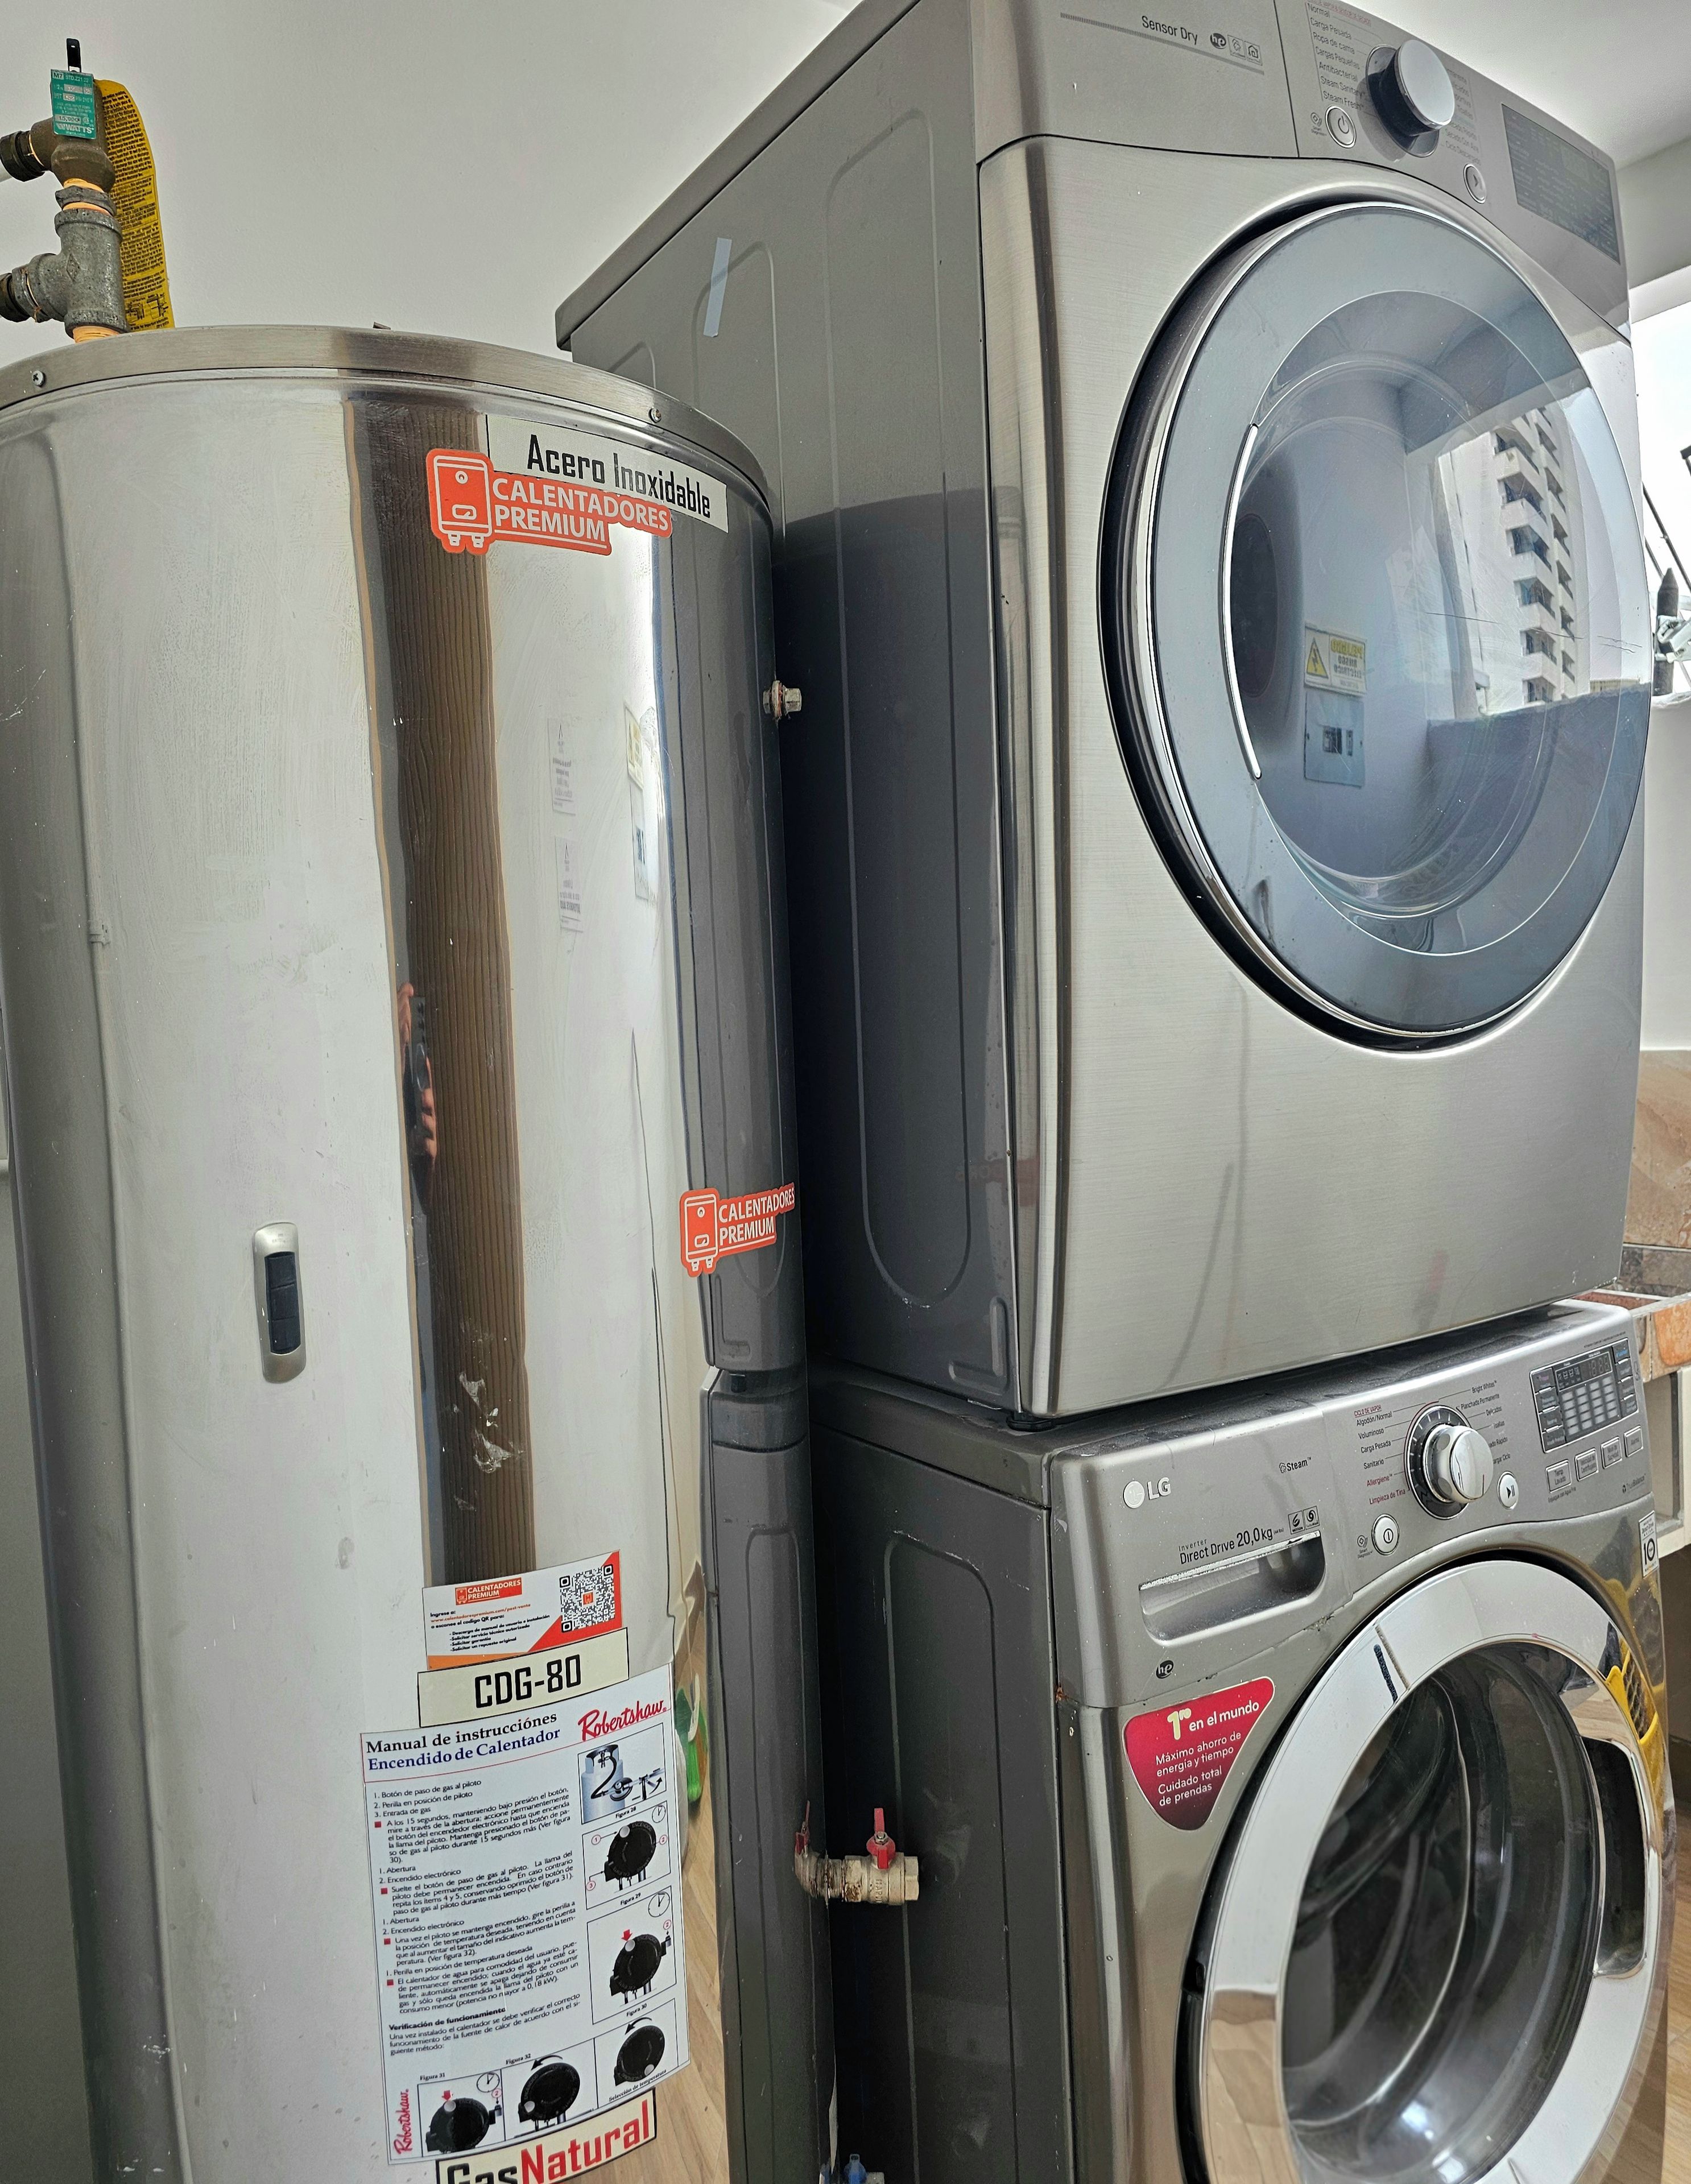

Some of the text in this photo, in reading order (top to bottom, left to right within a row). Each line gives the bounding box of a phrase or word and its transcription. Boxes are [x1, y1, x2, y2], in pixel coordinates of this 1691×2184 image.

[1308, 3, 1330, 18] Normal
[1142, 15, 1177, 36] Sensor
[1180, 27, 1198, 45] Dry
[1310, 17, 1351, 40] Carga Pesada
[1313, 32, 1354, 54] Ropa de cama
[1315, 46, 1334, 60] Cargas
[1320, 61, 1358, 82] Antibacterial
[1321, 76, 1339, 89] Steam
[1324, 91, 1343, 104] Steam
[527, 434, 710, 519] Acero Inoxidable
[493, 478, 668, 531] CALENTADORES
[495, 506, 605, 542] PREMIUM
[719, 1188, 795, 1223] CALENTADORES
[720, 1216, 774, 1246] PREMIUM
[1471, 1384, 1483, 1393] Bright
[1461, 1393, 1499, 1410] Planchado Permanente
[1357, 1412, 1392, 1426] Algodón/Normal
[1358, 1428, 1384, 1440] Voluminoso
[1361, 1440, 1391, 1453] Carga Pesada
[1363, 1458, 1384, 1469] Sanitario
[1147, 1477, 1171, 1500] LG
[1369, 1494, 1390, 1505] Limpieza
[1396, 1488, 1405, 1497] Tina
[1179, 1539, 1207, 1552] Inverter
[1180, 1548, 1209, 1564] Direct
[1211, 1541, 1235, 1556] Drive
[468, 1579, 521, 1592] CALENTADORES
[468, 1590, 499, 1600] PREMIUM
[506, 1624, 530, 1632] autorizado
[475, 1654, 581, 1709] CDG-80
[1189, 1719, 1204, 1732] en
[1207, 1711, 1217, 1726] el
[1220, 1701, 1259, 1720] mundo
[366, 1713, 557, 1753] Manual de instrucciónes
[369, 1728, 560, 1771] Encendido de Calentador
[1155, 1731, 1242, 1765] Máximo ahorro de
[1157, 1747, 1234, 1777] energía y tiempo
[462, 1779, 481, 1789] piloto
[1158, 1765, 1222, 1794] Cuidado total
[414, 1795, 441, 1806] posición
[453, 1790, 473, 1801] piloto
[1159, 1782, 1212, 1806] de prendas
[382, 1808, 408, 1817] Entrada
[416, 1814, 450, 1824] segundos,
[452, 1805, 497, 1818] manteniendo
[498, 1801, 512, 1809] bajo
[514, 1794, 539, 1807] presión
[547, 1787, 568, 1797] botón,
[615, 1809, 630, 1819] Figura
[621, 1895, 634, 1905] Figura
[388, 2020, 433, 2030] Verificación
[446, 2007, 506, 2024] funcionamiento
[626, 2008, 640, 2017] Figura
[506, 2057, 524, 2065] Figura
[609, 2088, 632, 2102] Selección
[639, 2069, 667, 2086] temperatura
